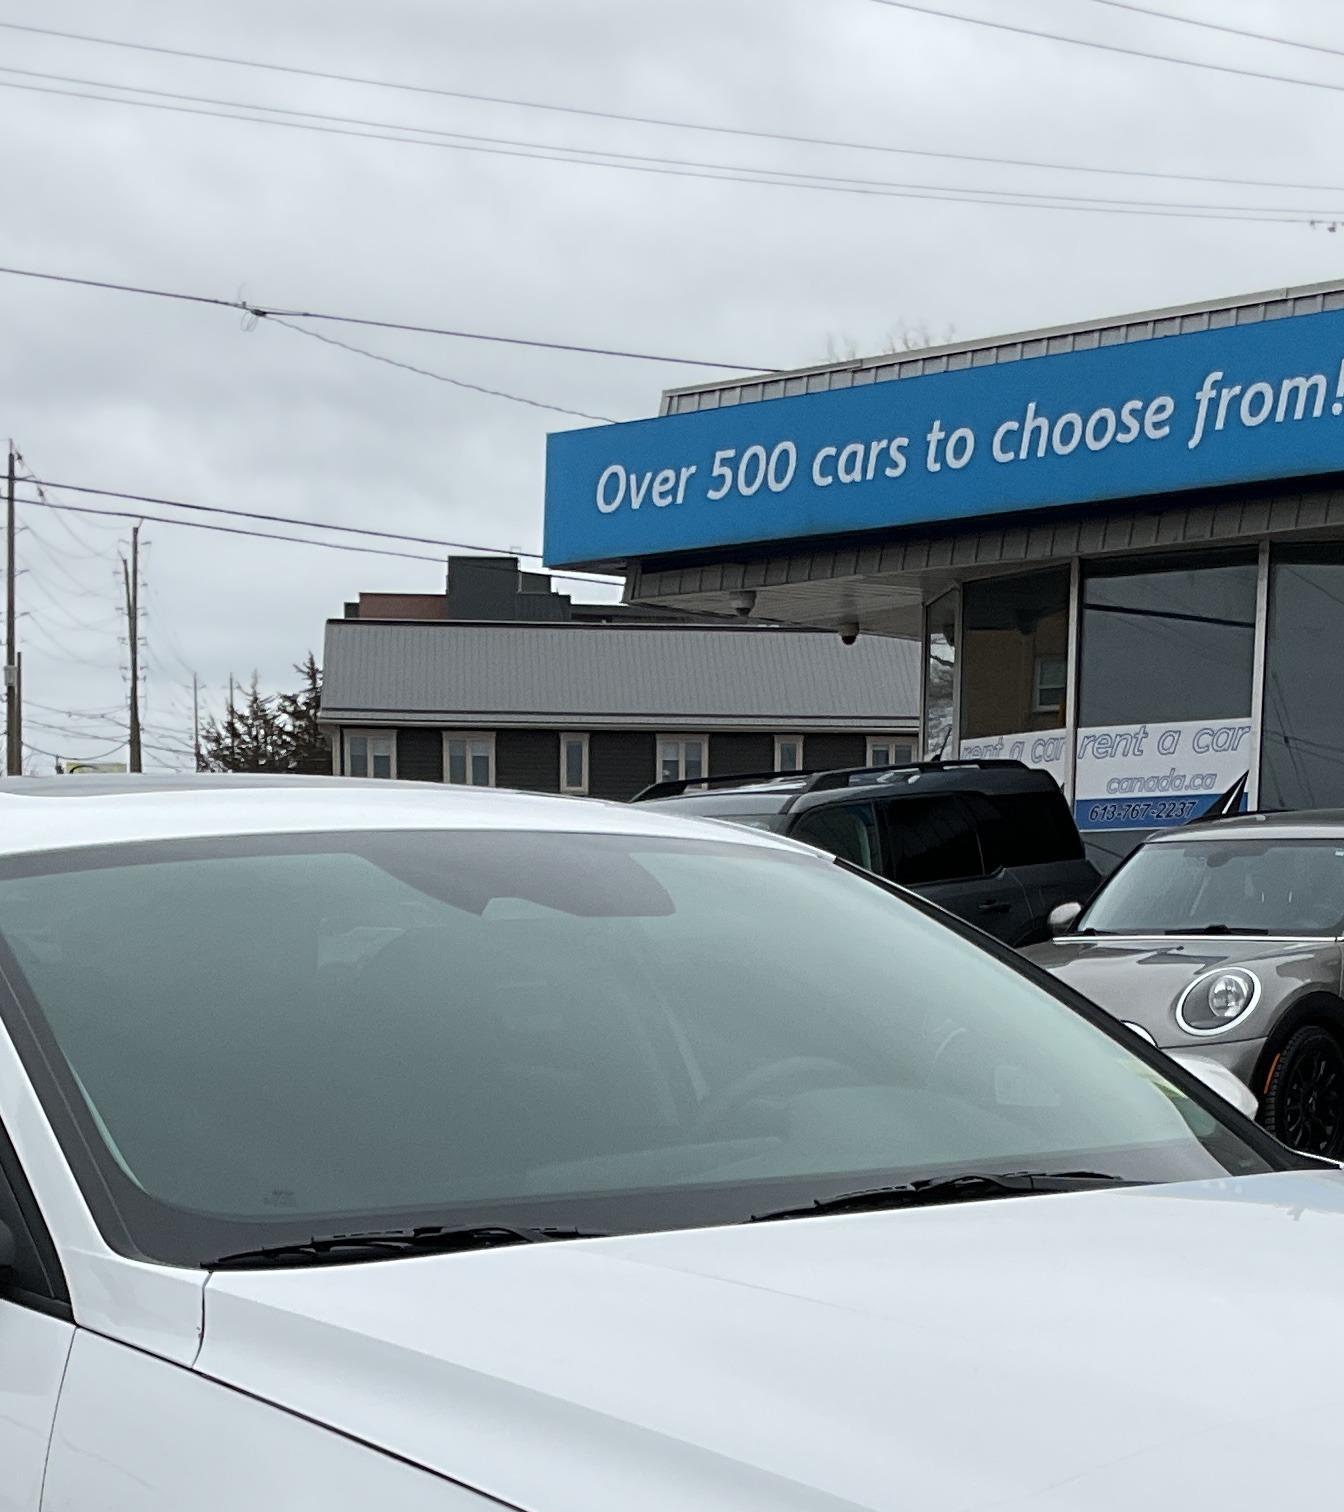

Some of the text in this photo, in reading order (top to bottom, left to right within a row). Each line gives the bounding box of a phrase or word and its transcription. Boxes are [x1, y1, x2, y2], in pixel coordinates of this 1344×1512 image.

[595, 463, 698, 514] Over
[706, 440, 797, 501] 500
[812, 436, 910, 487] cars
[926, 419, 975, 473] to
[992, 395, 1175, 464] choose
[1030, 736, 1066, 764] car
[1077, 724, 1252, 761] rent a car
[1106, 768, 1217, 795] canada.ca
[1089, 801, 1198, 823] 613-767-2237
